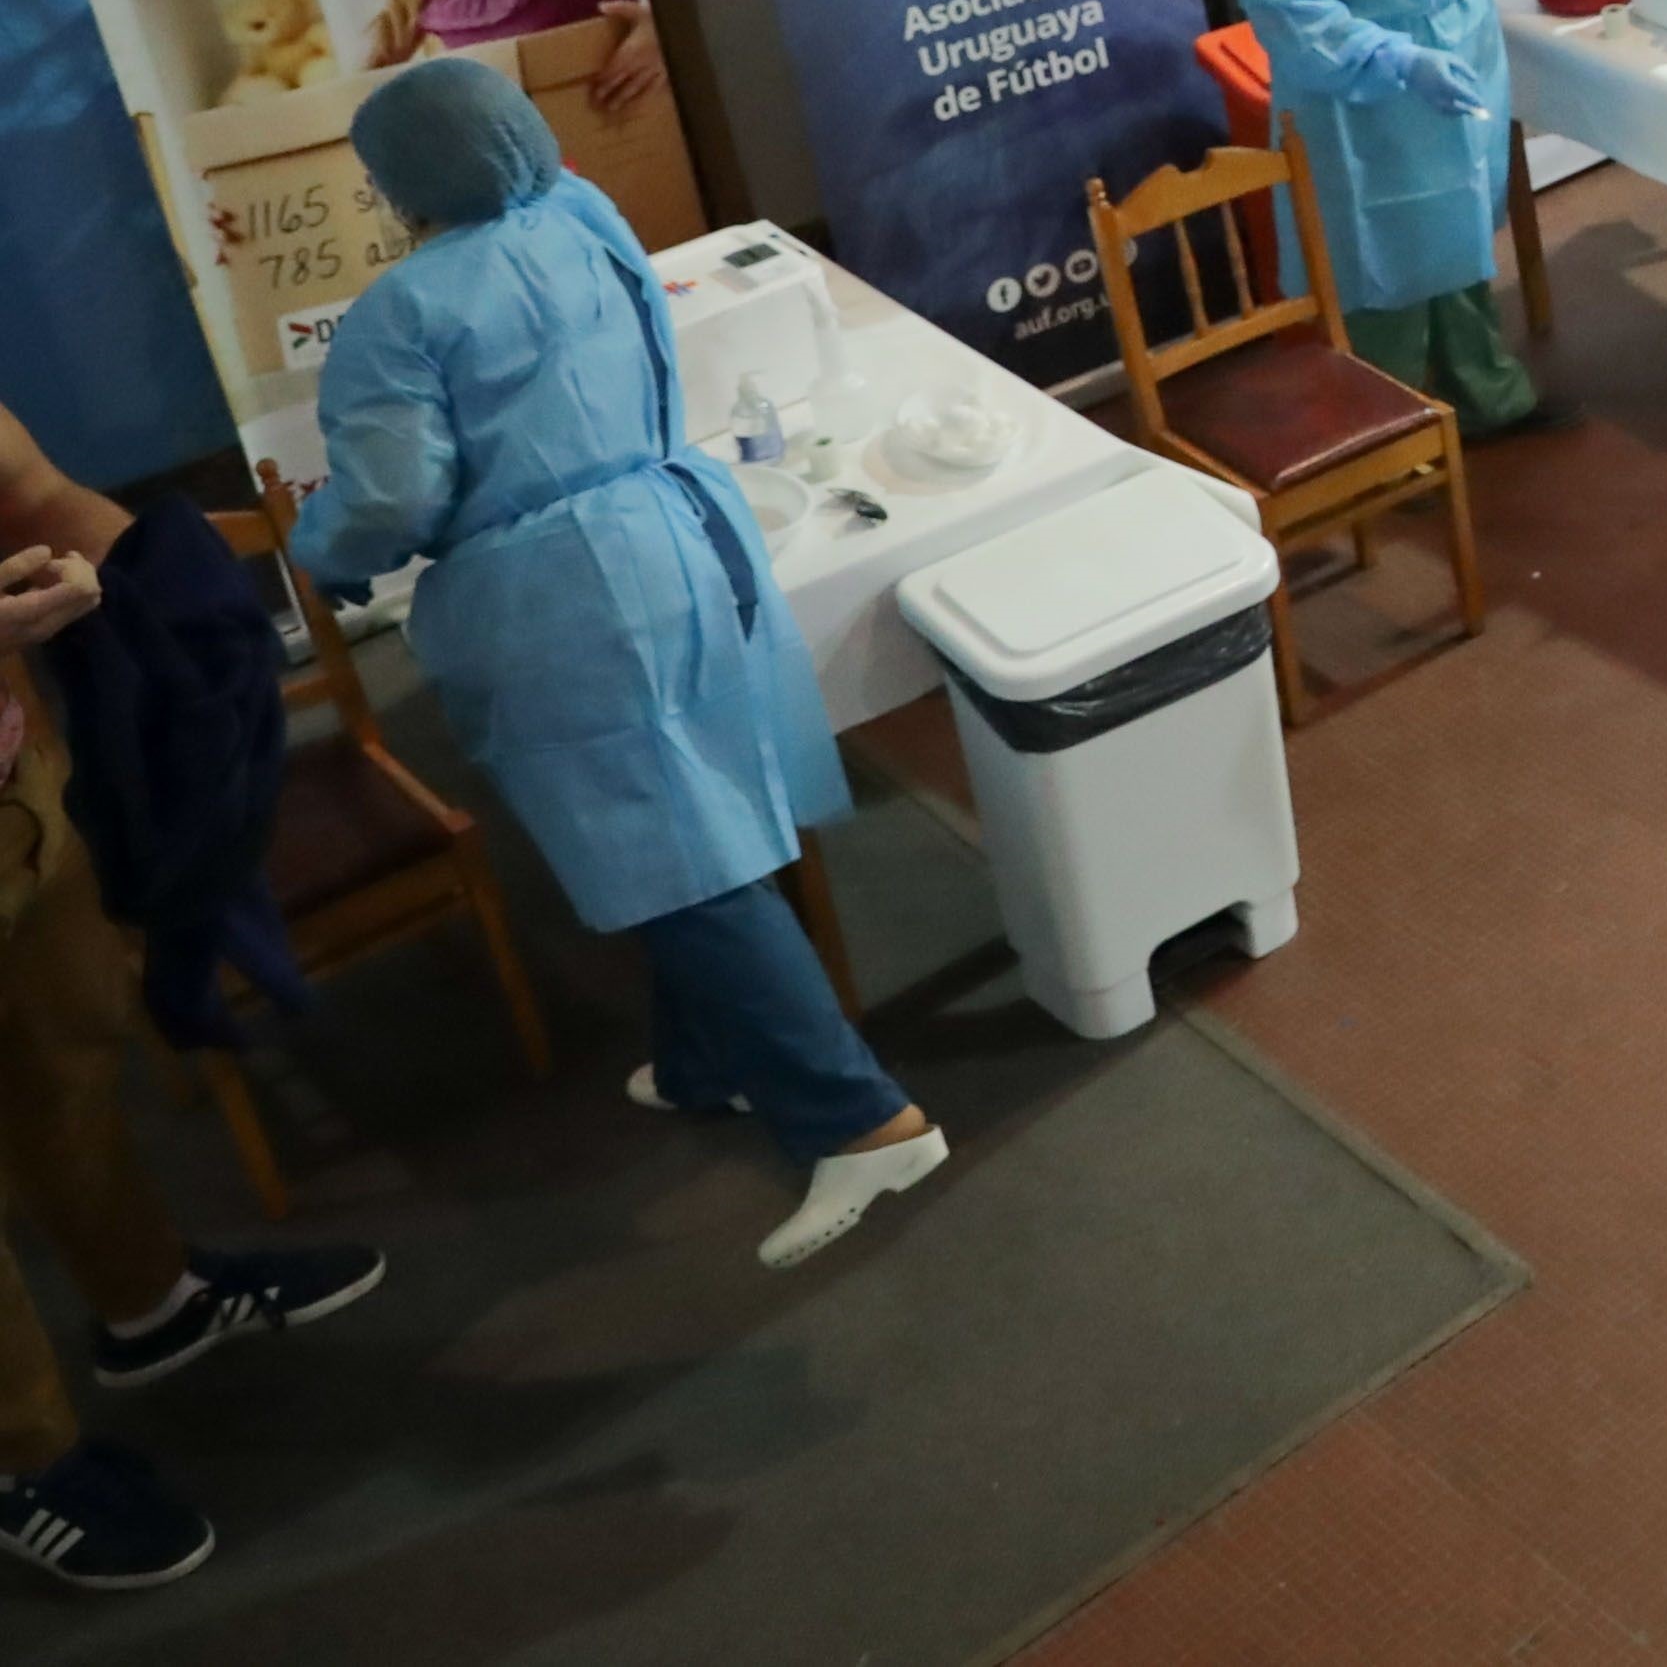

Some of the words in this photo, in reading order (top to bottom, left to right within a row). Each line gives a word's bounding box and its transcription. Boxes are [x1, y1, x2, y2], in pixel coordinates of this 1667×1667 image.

[933, 85, 982, 122] de
[987, 36, 1110, 103] Fútbol
[258, 238, 342, 289] 785
